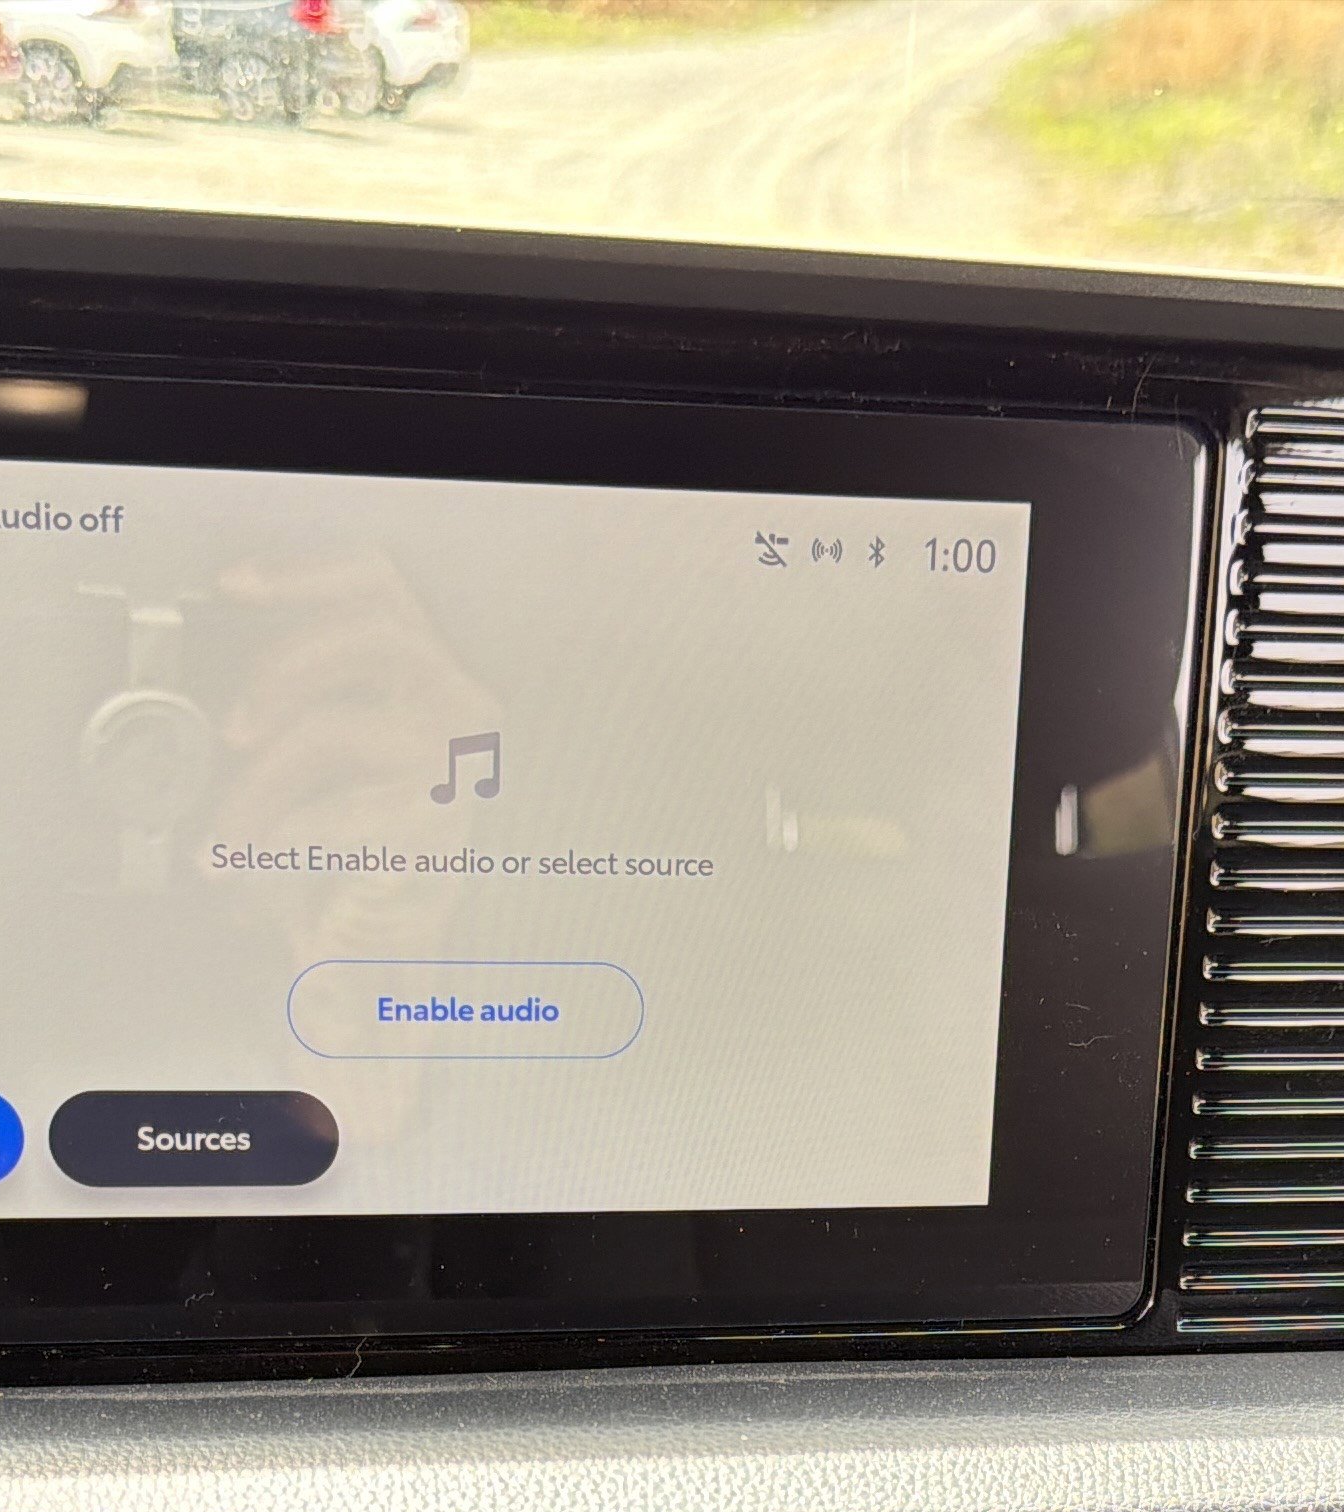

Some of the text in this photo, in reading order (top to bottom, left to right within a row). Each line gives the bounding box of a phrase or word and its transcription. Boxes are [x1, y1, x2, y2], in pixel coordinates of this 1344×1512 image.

[78, 504, 126, 535] off
[922, 536, 998, 575] 1:00
[210, 843, 715, 878] Select Enable audio or select source
[377, 996, 560, 1024] Enable audio
[136, 1126, 252, 1152] Sources
